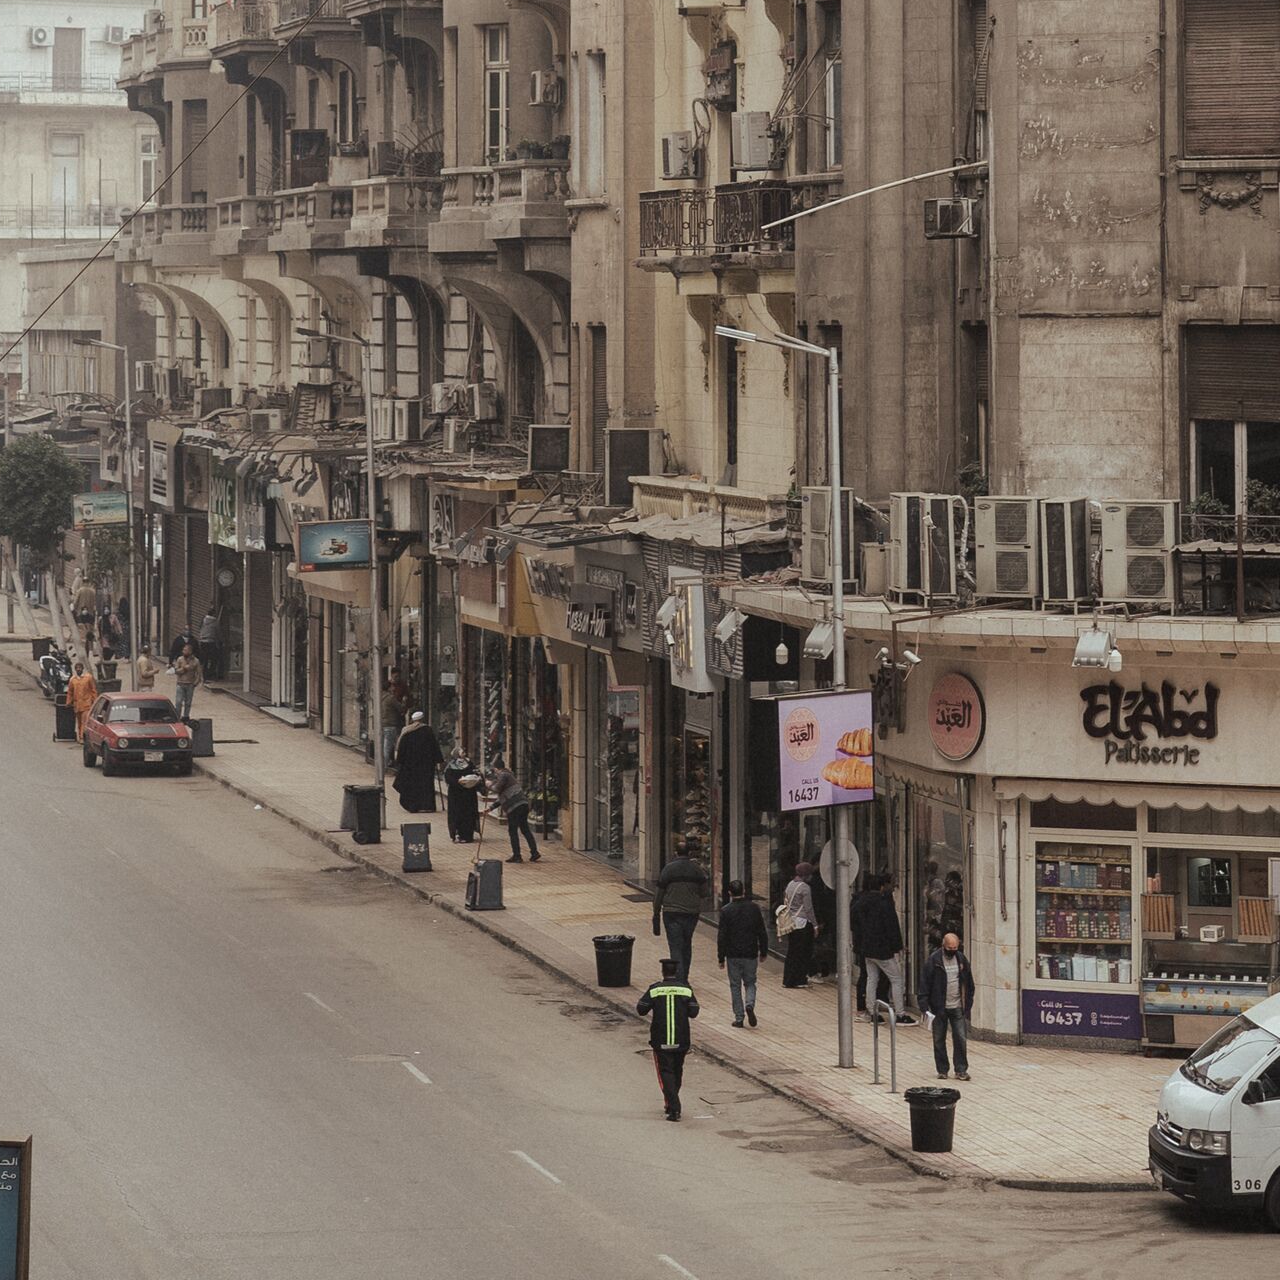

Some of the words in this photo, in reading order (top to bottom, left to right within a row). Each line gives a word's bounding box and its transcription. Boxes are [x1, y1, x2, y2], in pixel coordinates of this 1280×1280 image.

[936, 700, 972, 733] العبد
[789, 722, 814, 746] العبد
[1104, 739, 1200, 766] Patisserie
[788, 787, 819, 803] 16437
[1040, 1000, 1054, 1008] Call
[1040, 1010, 1082, 1026] 16437
[1, 1170, 17, 1180] مع
